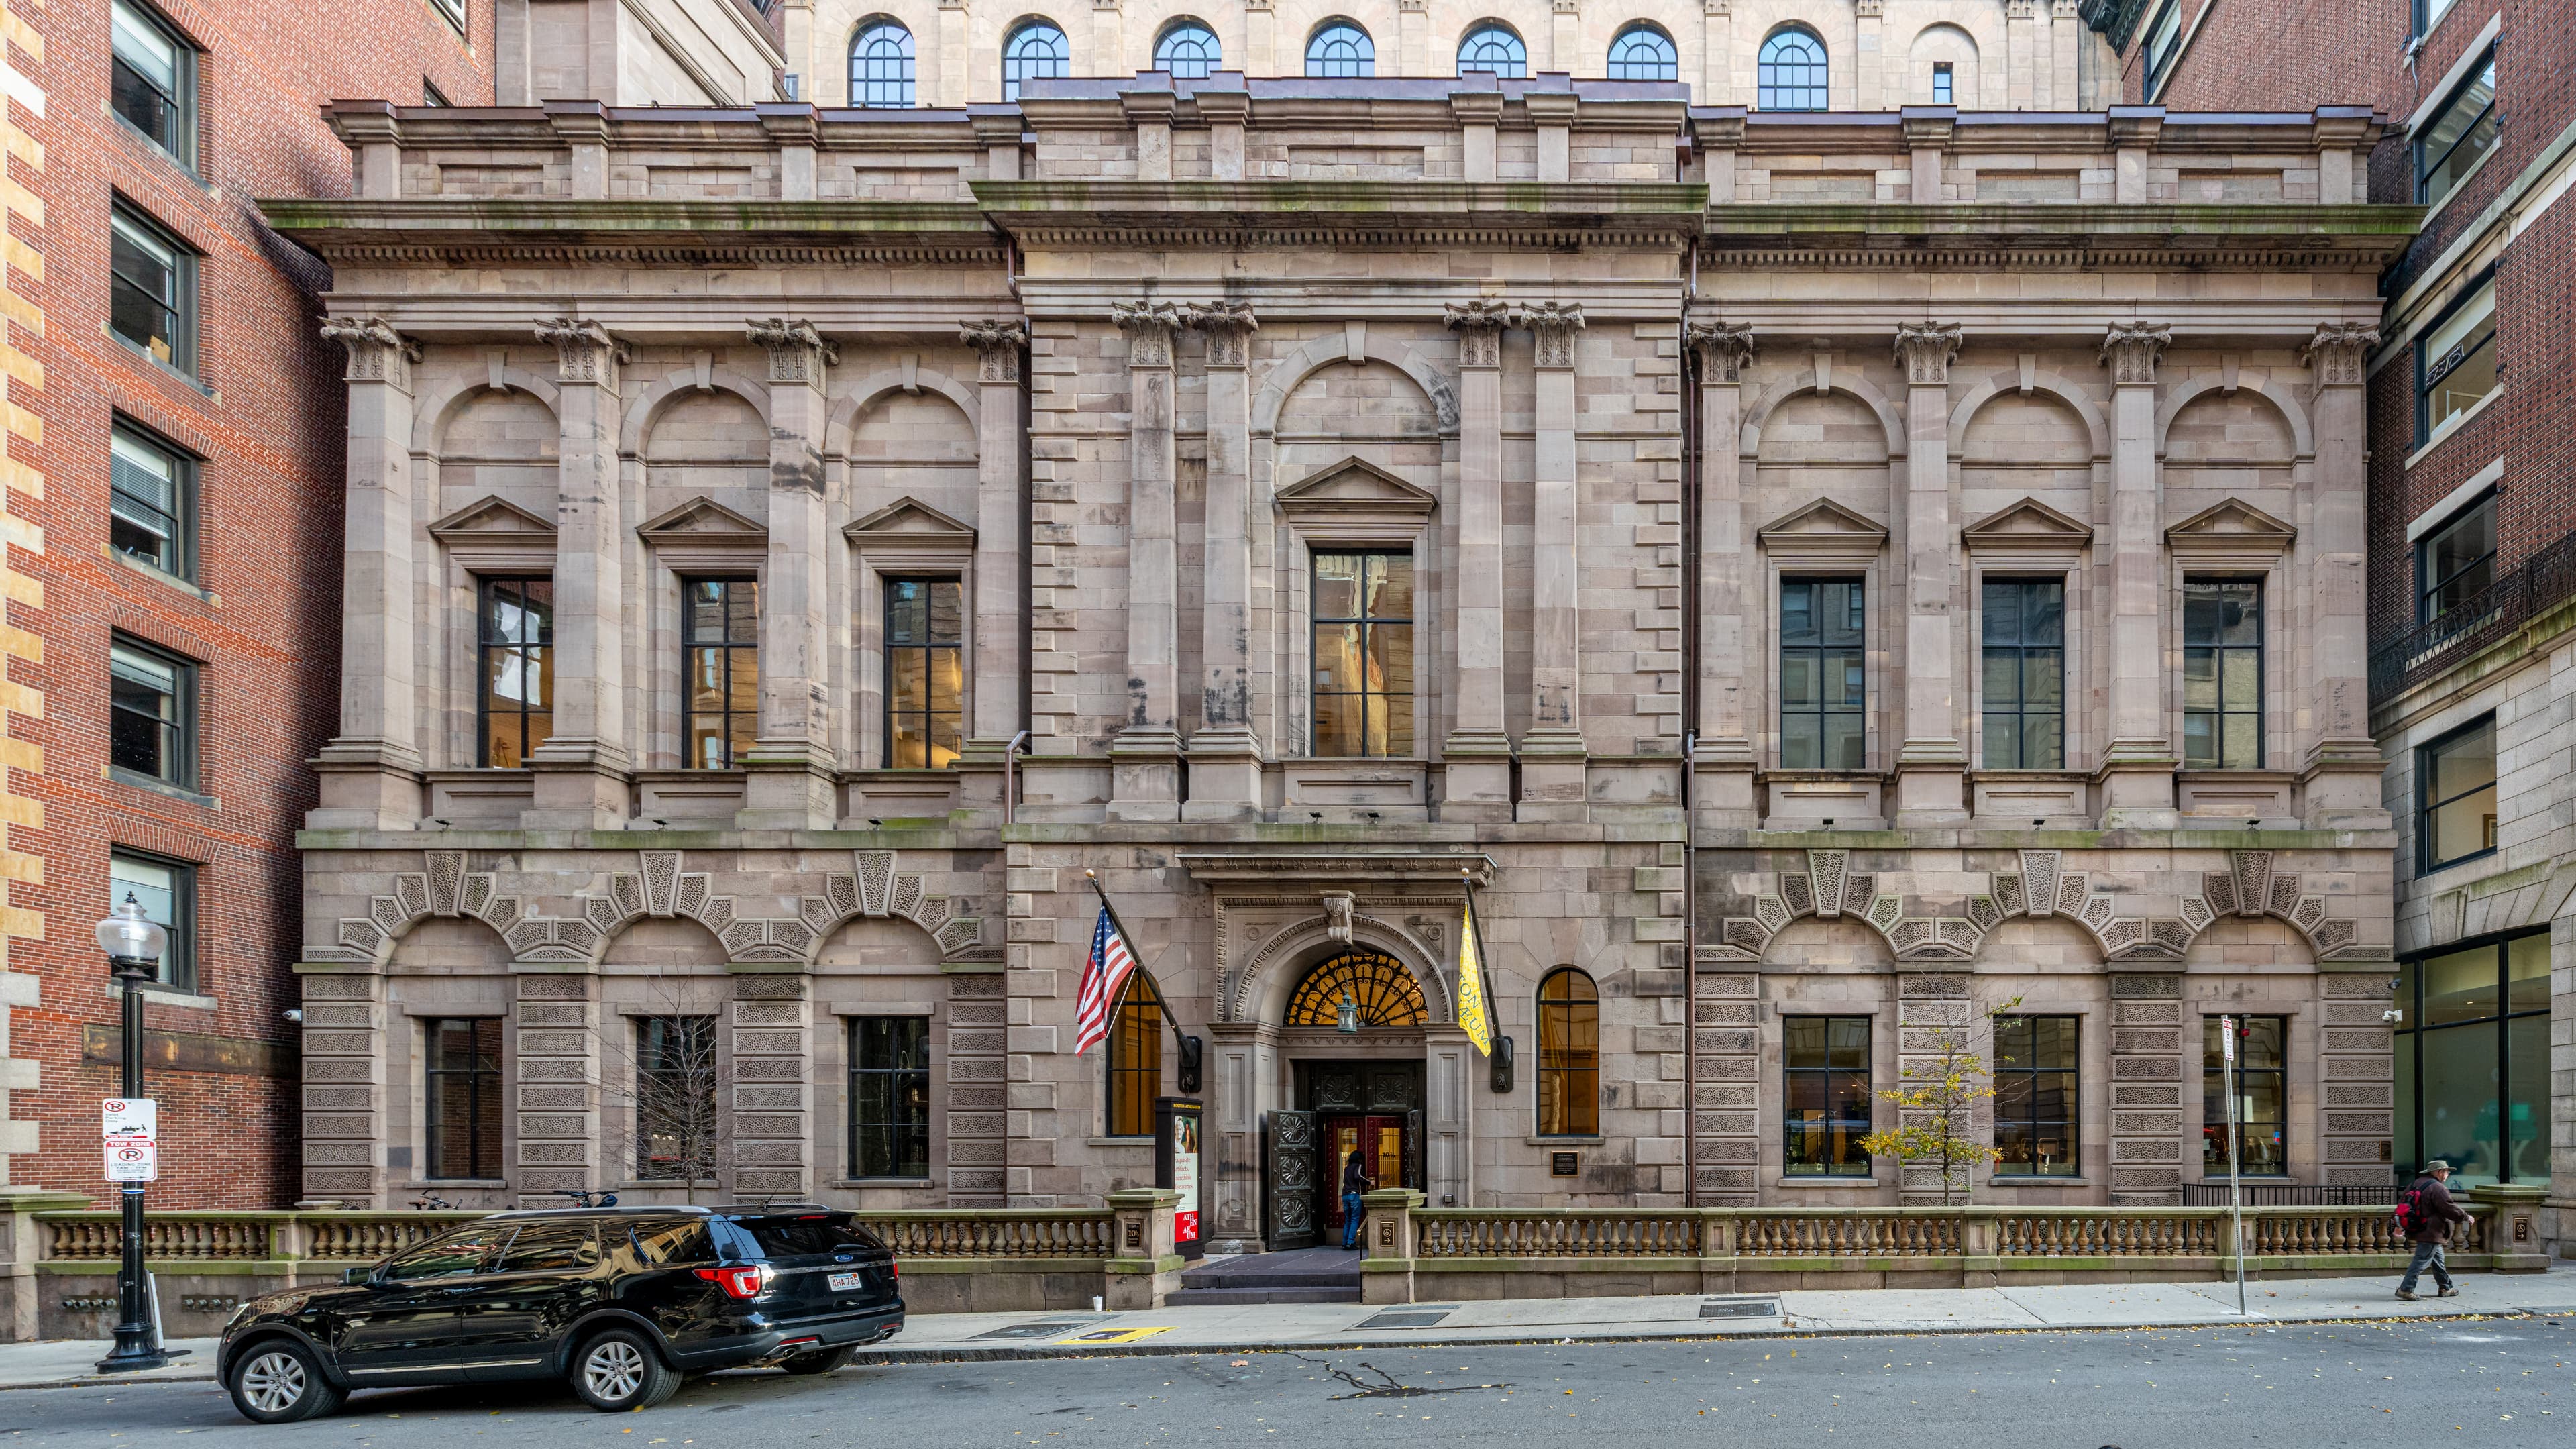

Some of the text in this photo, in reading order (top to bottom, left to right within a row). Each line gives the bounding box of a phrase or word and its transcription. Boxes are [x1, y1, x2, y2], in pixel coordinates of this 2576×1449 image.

[1183, 1213, 1194, 1221] ATH
[1189, 1218, 1197, 1226] EN
[1187, 1231, 1196, 1240] UM
[832, 1277, 859, 1287] 4HA 725
